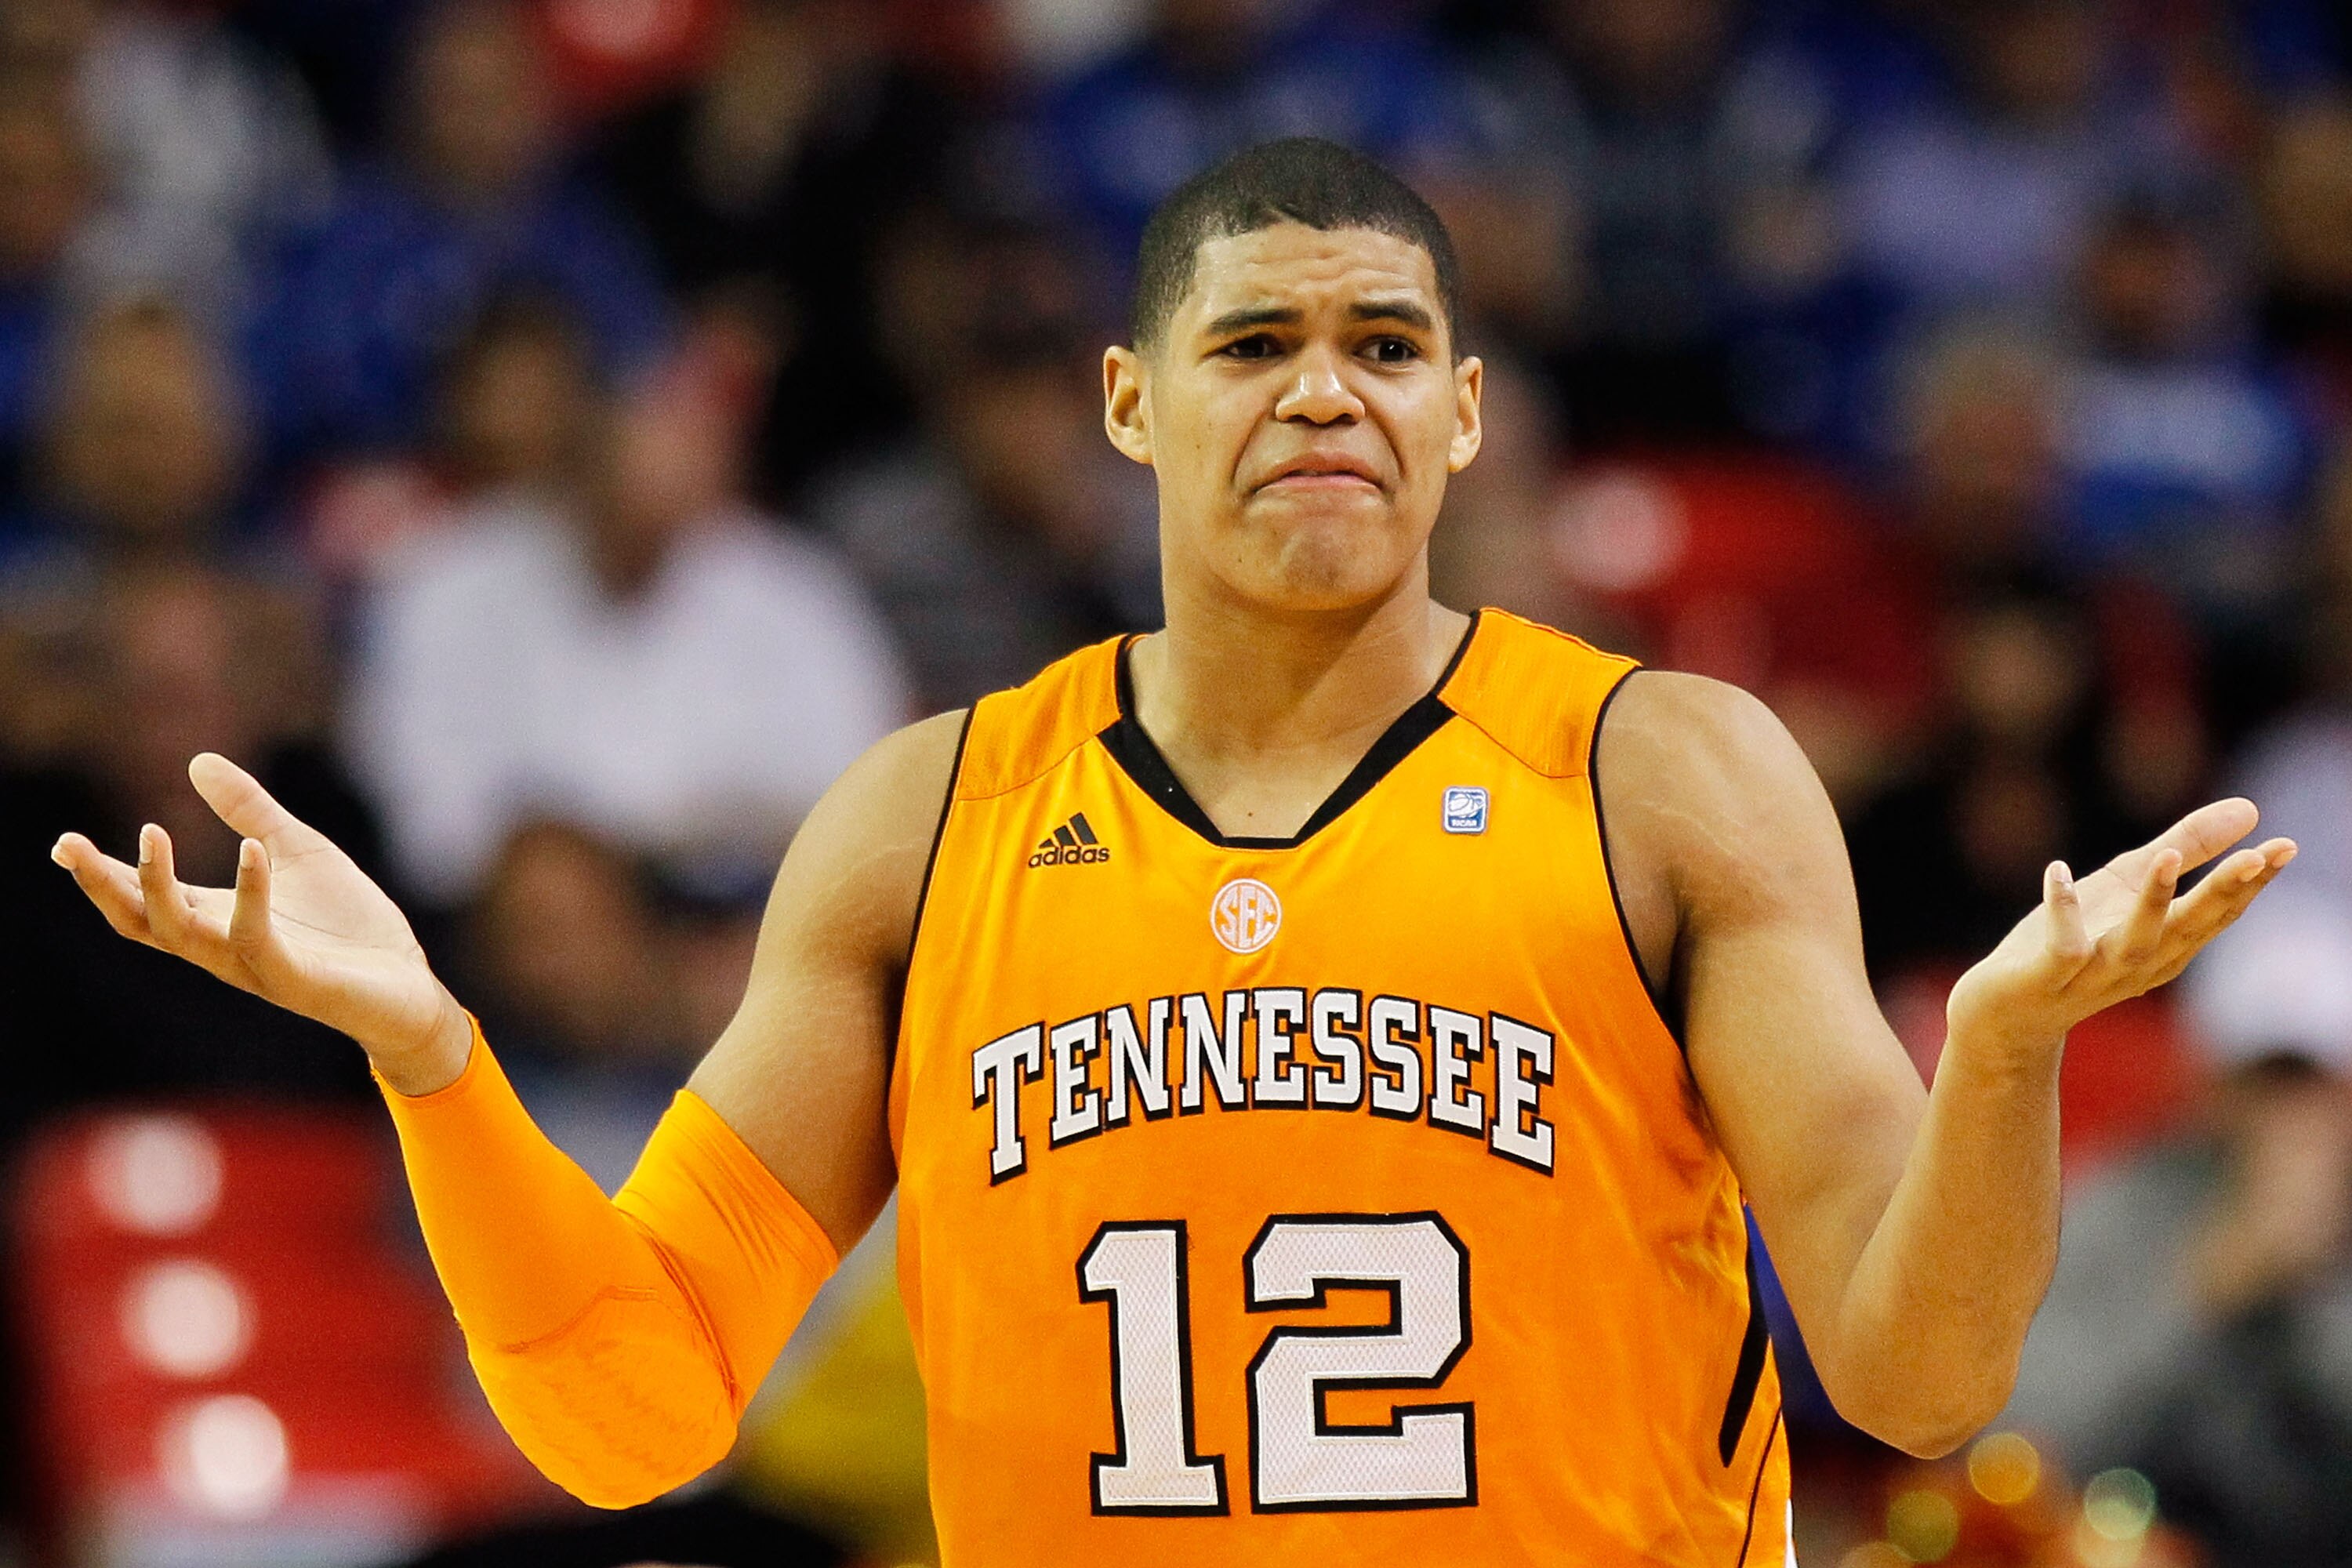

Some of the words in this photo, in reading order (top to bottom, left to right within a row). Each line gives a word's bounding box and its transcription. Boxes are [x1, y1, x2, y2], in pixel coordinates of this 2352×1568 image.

[1029, 847, 1109, 868] adidas
[1220, 885, 1275, 948] SEC
[973, 986, 1555, 1185] TENNESSEE
[1076, 1210, 1478, 1517] 12
